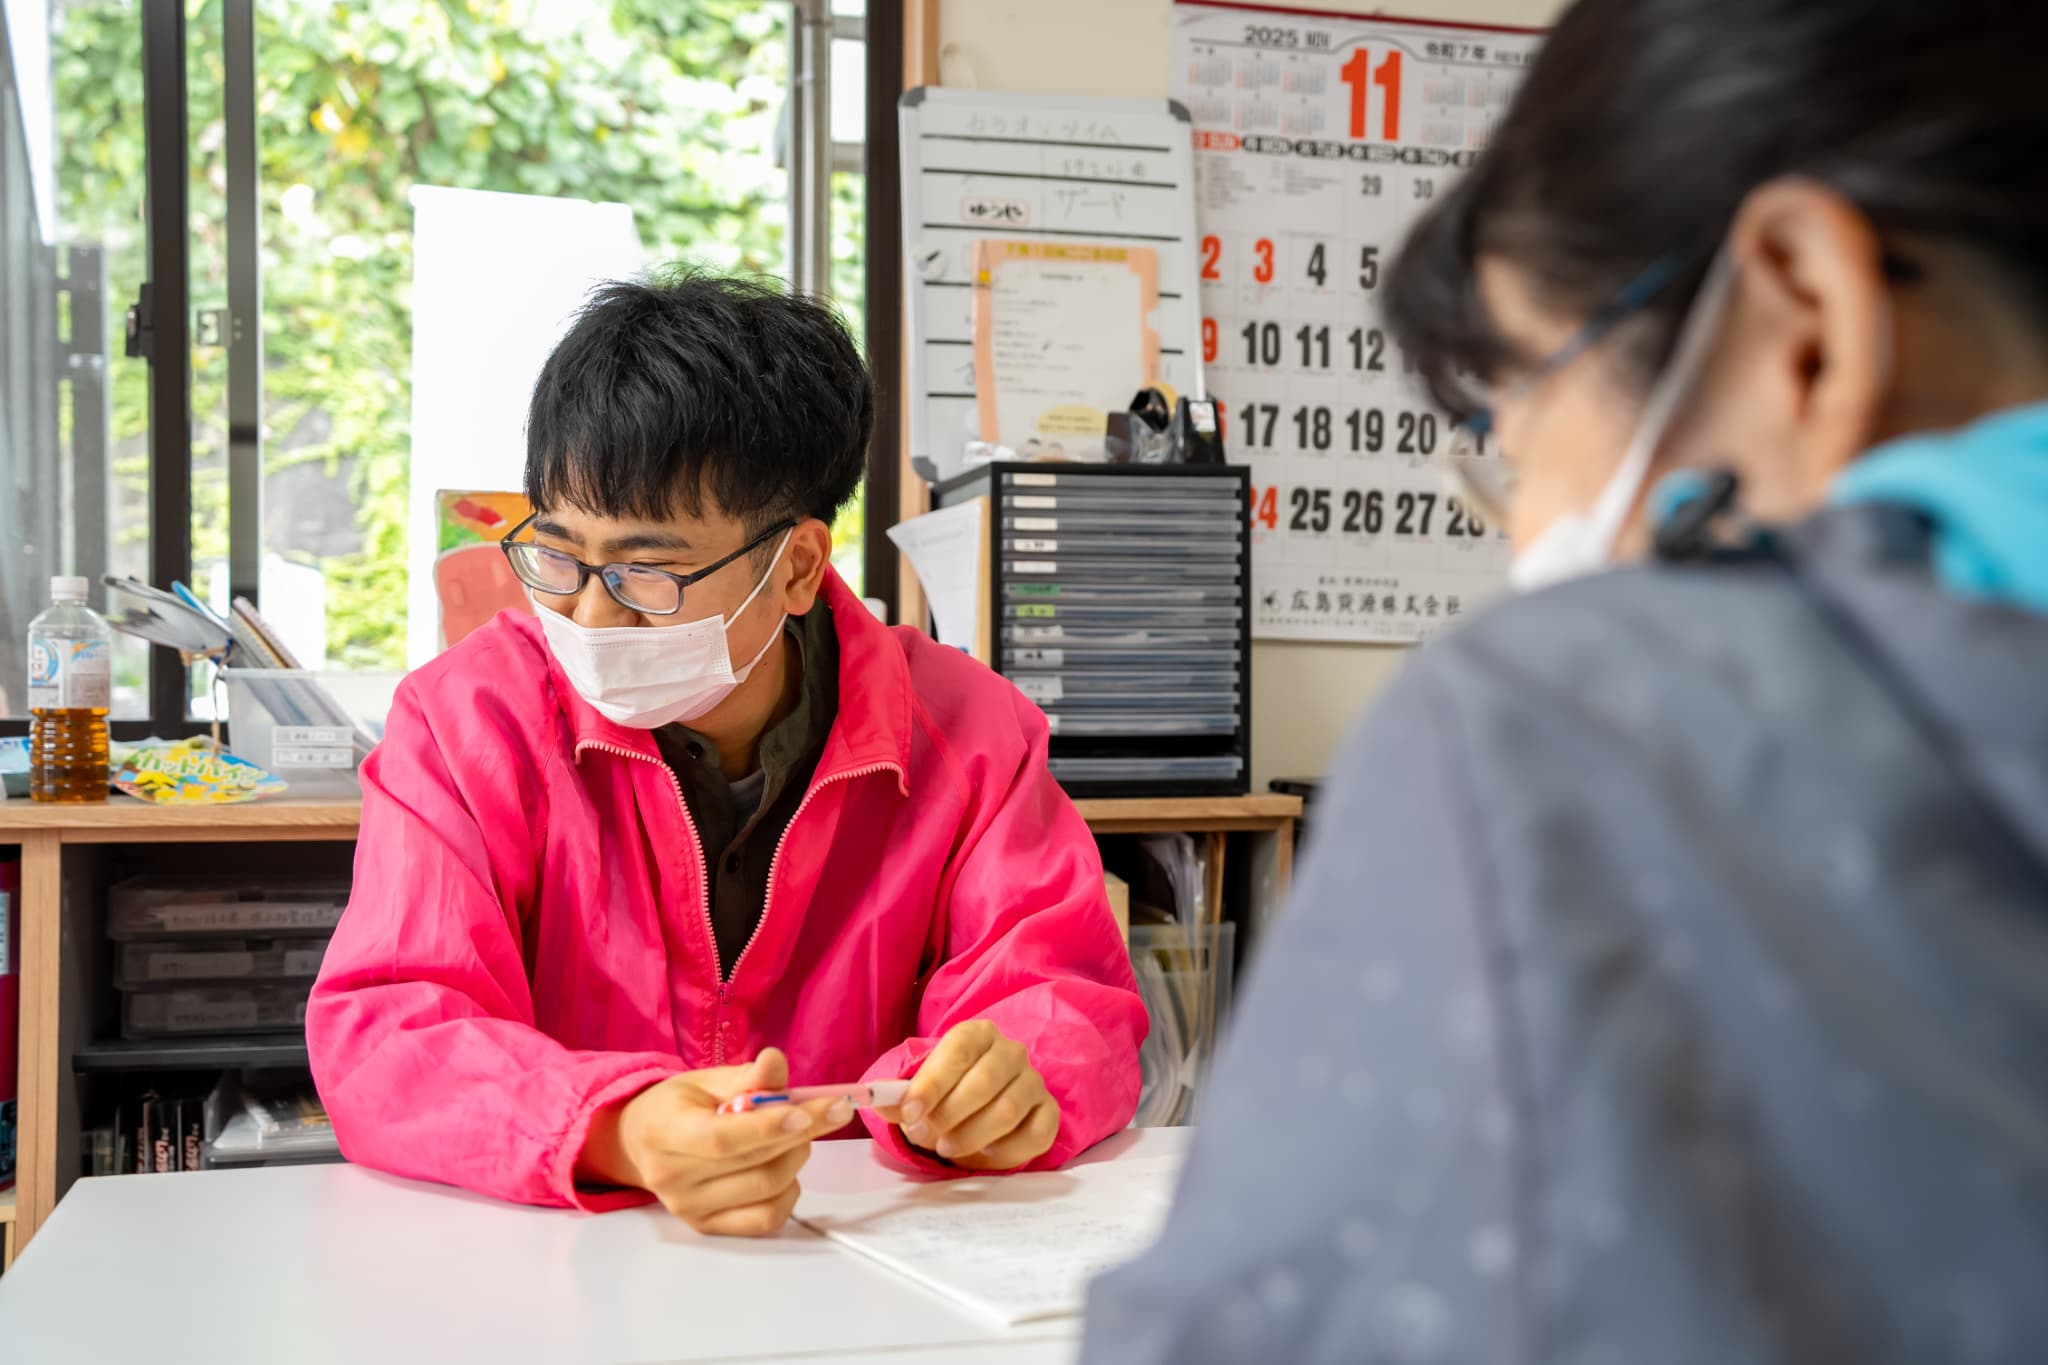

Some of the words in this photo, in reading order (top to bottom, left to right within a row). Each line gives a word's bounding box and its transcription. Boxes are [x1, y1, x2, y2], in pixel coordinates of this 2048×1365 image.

[1245, 25, 1298, 48] 2025
[1341, 48, 1403, 141] 11
[1361, 175, 1382, 196] 29
[1413, 179, 1434, 200] 30
[1200, 235, 1221, 280] 2
[1254, 238, 1275, 284] 3
[1307, 243, 1327, 286] 4
[1359, 246, 1380, 289] 5
[1202, 317, 1218, 363] 9
[1242, 321, 1281, 366] 10
[1296, 325, 1330, 368] 11
[1348, 328, 1385, 371] 12
[1240, 403, 1280, 448] 17
[1293, 406, 1332, 450] 18
[1345, 408, 1384, 453] 19
[1397, 411, 1436, 455] 20
[1290, 488, 1331, 532] 25
[1343, 490, 1384, 534] 26
[1395, 493, 1437, 535] 27
